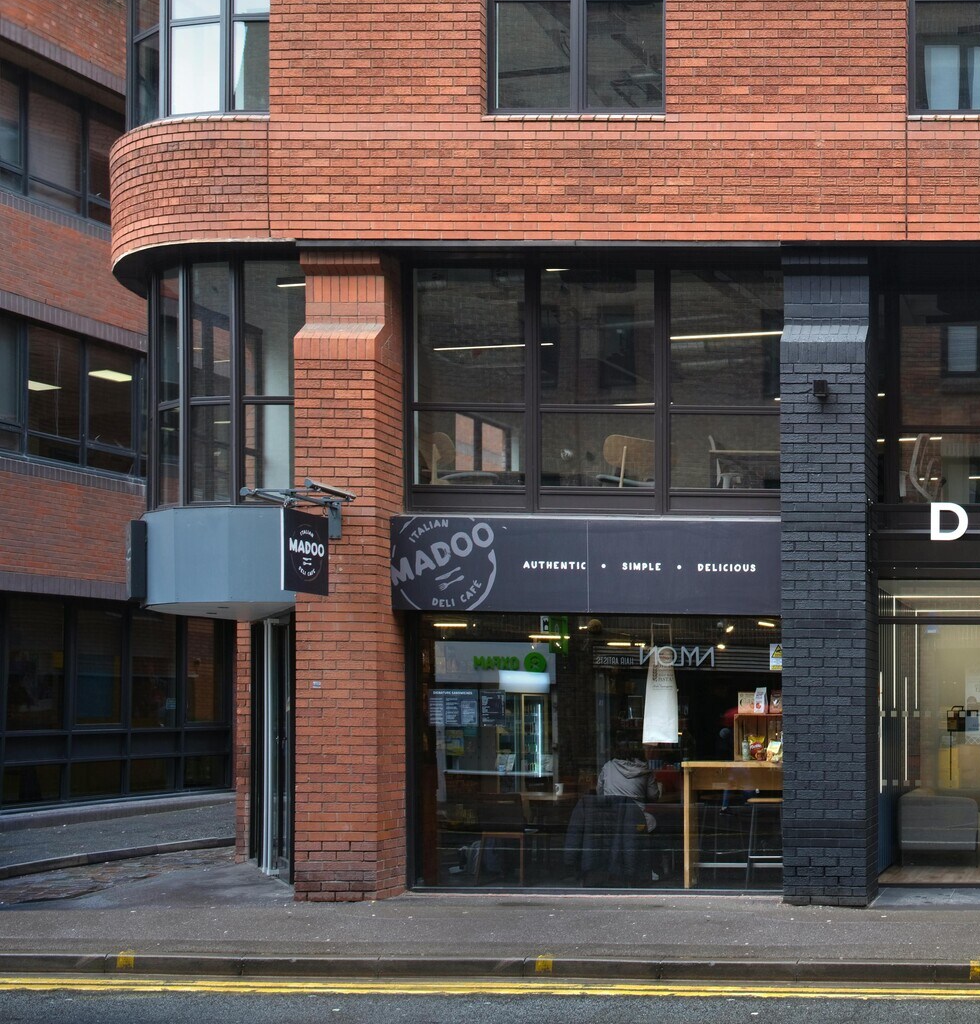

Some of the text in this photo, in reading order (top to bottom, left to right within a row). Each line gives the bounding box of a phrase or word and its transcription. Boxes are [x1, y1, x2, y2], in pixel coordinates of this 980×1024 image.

[300, 529, 314, 538] ITALIAN
[408, 519, 449, 543] ITALIAN
[289, 537, 325, 558] MADOO
[390, 522, 495, 587] MADOO
[523, 560, 757, 572] AUTHENTIC SIMPLE DELICIOUS
[431, 579, 482, 607] DELI CAFÉ
